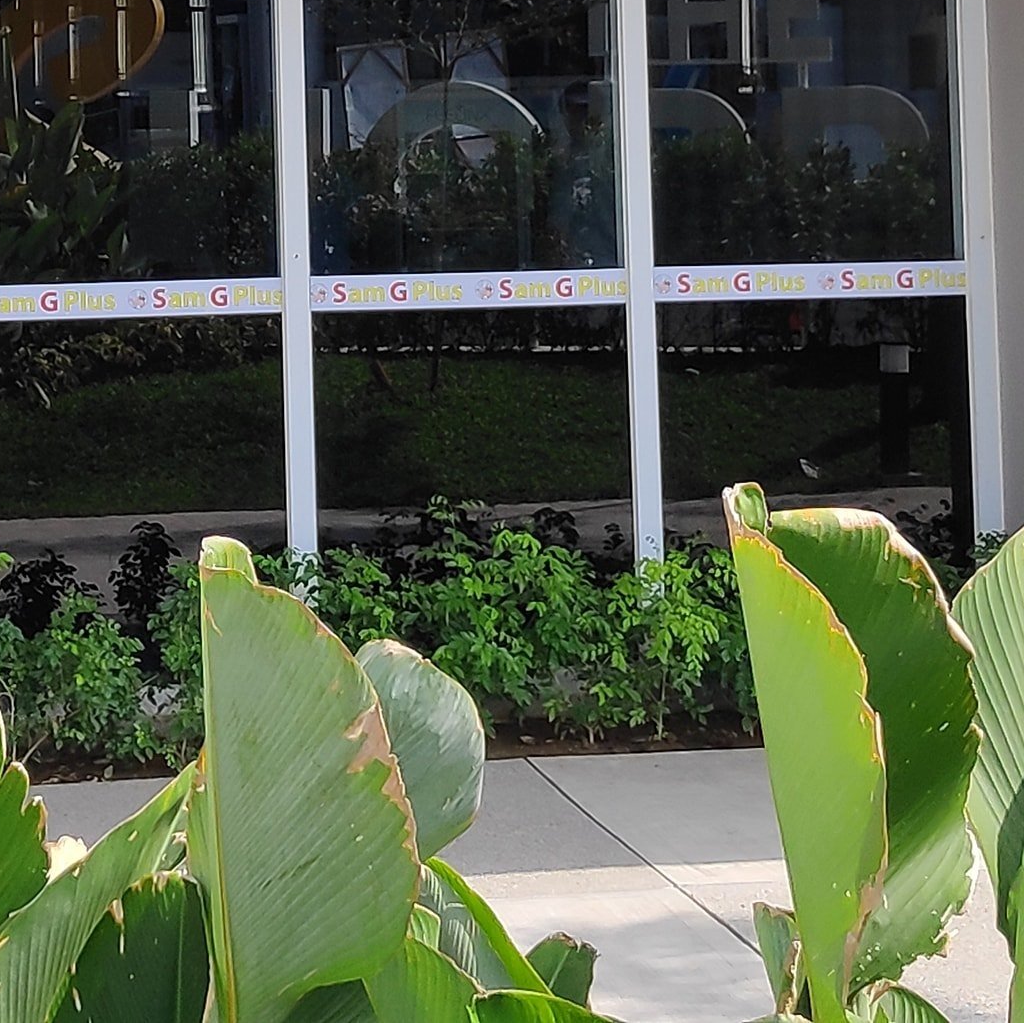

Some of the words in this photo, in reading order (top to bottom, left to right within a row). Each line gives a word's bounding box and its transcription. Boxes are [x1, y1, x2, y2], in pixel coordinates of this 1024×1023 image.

[333, 283, 385, 304] Sam
[412, 280, 463, 301] Plus
[499, 279, 551, 299] Sam
[678, 274, 728, 294] Sam
[755, 271, 805, 292] Plus
[64, 290, 116, 312] Plus
[153, 288, 206, 309] Sam
